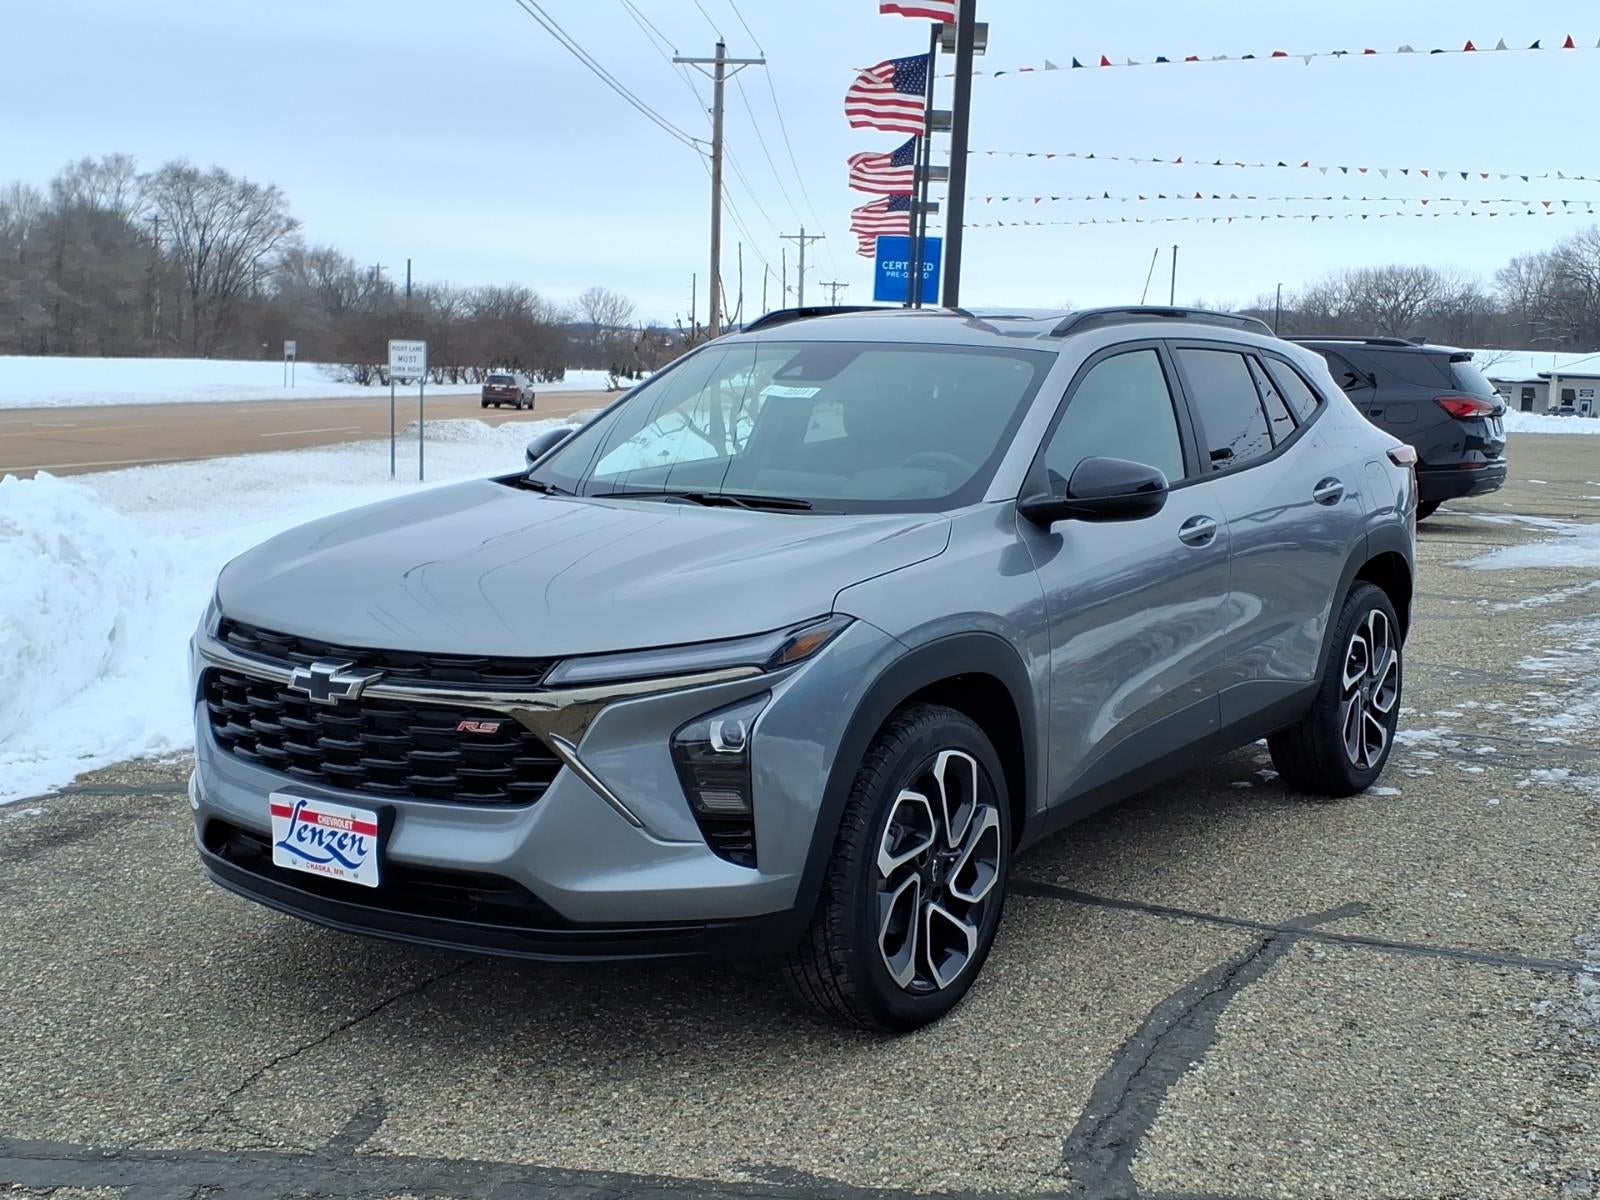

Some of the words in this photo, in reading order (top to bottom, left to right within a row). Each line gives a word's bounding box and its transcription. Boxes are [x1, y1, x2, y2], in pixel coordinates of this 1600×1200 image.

[881, 260, 934, 272] CERTED
[409, 345, 422, 353] LANE
[398, 355, 417, 363] MUST
[456, 720, 500, 733] RS
[317, 814, 354, 830] CHEVROLET
[275, 799, 369, 869] Lenzen
[306, 862, 333, 875] CHASKA,
[334, 868, 344, 877] MN
